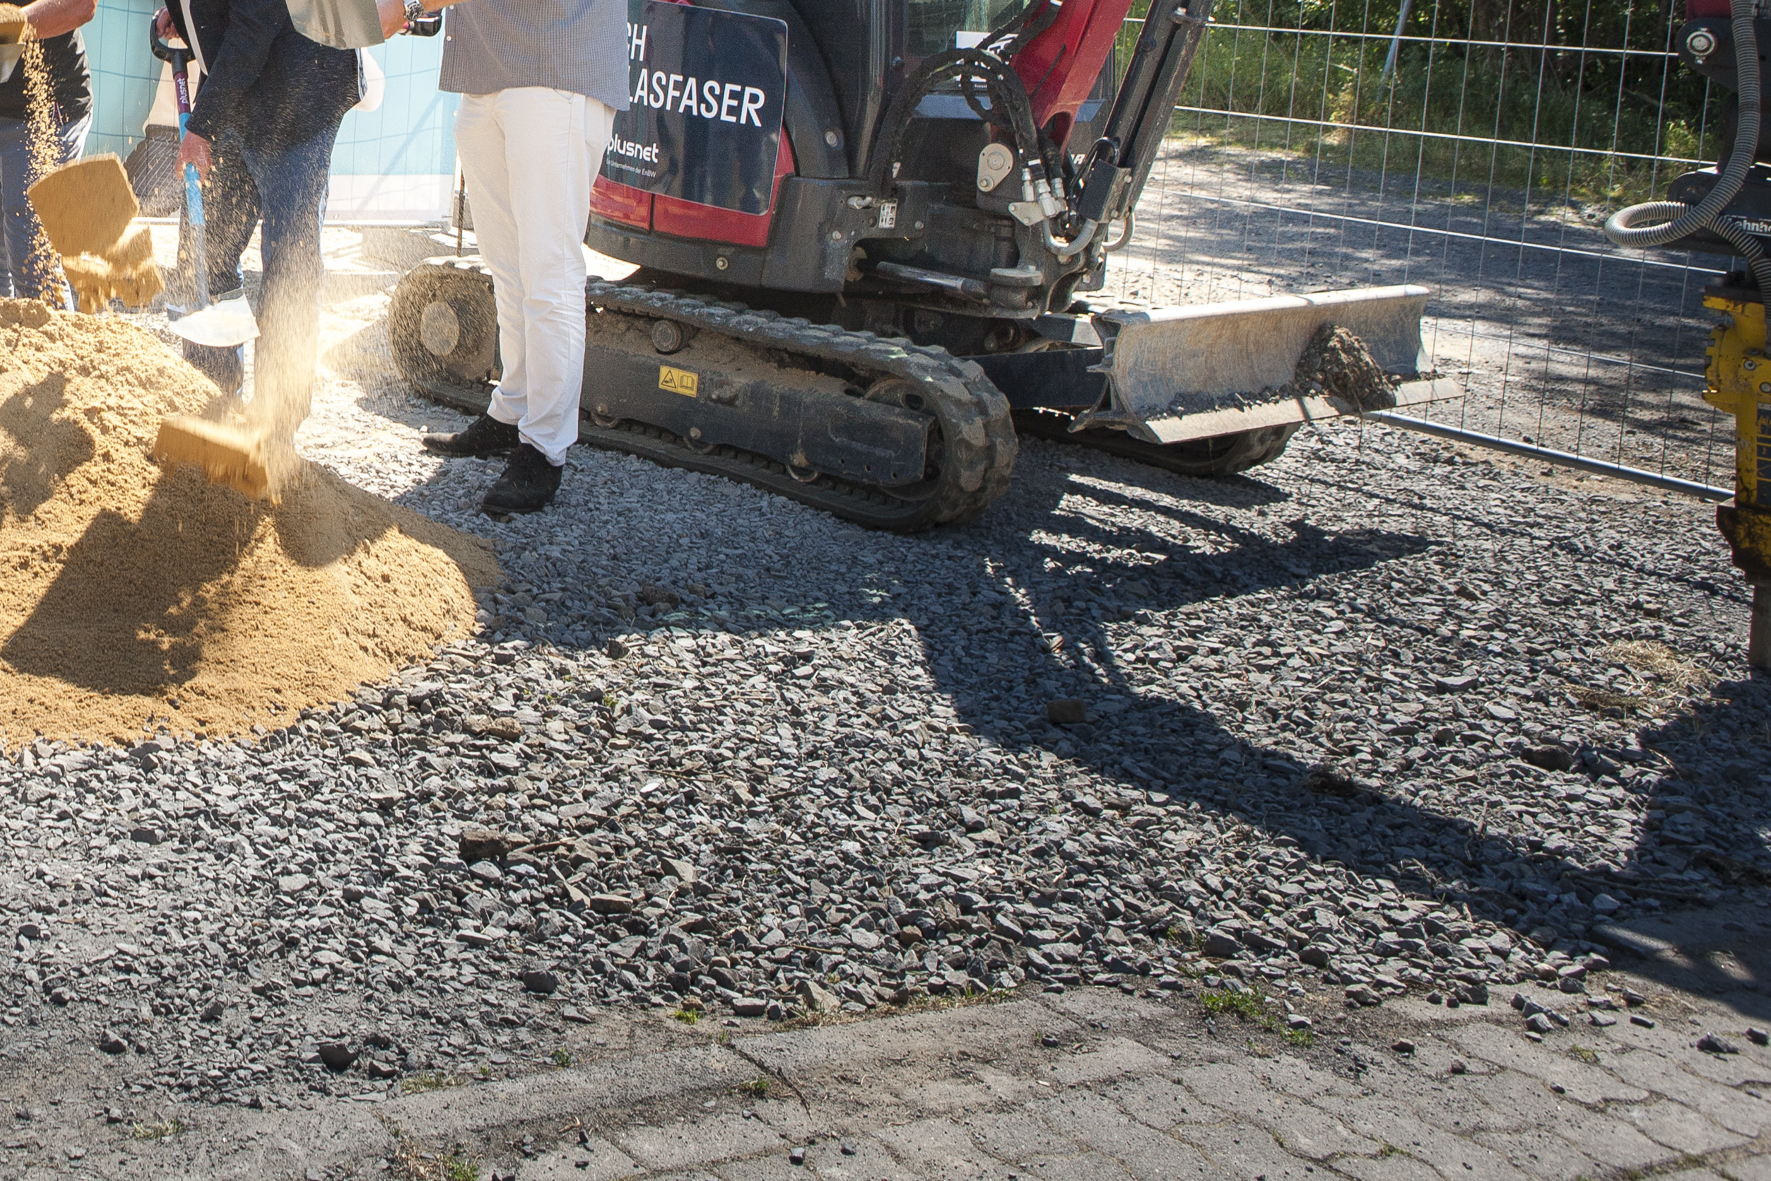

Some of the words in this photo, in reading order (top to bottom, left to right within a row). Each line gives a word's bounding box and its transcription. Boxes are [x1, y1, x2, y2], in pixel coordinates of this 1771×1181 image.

[177, 78, 190, 105] plusnet
[629, 67, 767, 128] ASFASER
[606, 133, 659, 164] plusnet
